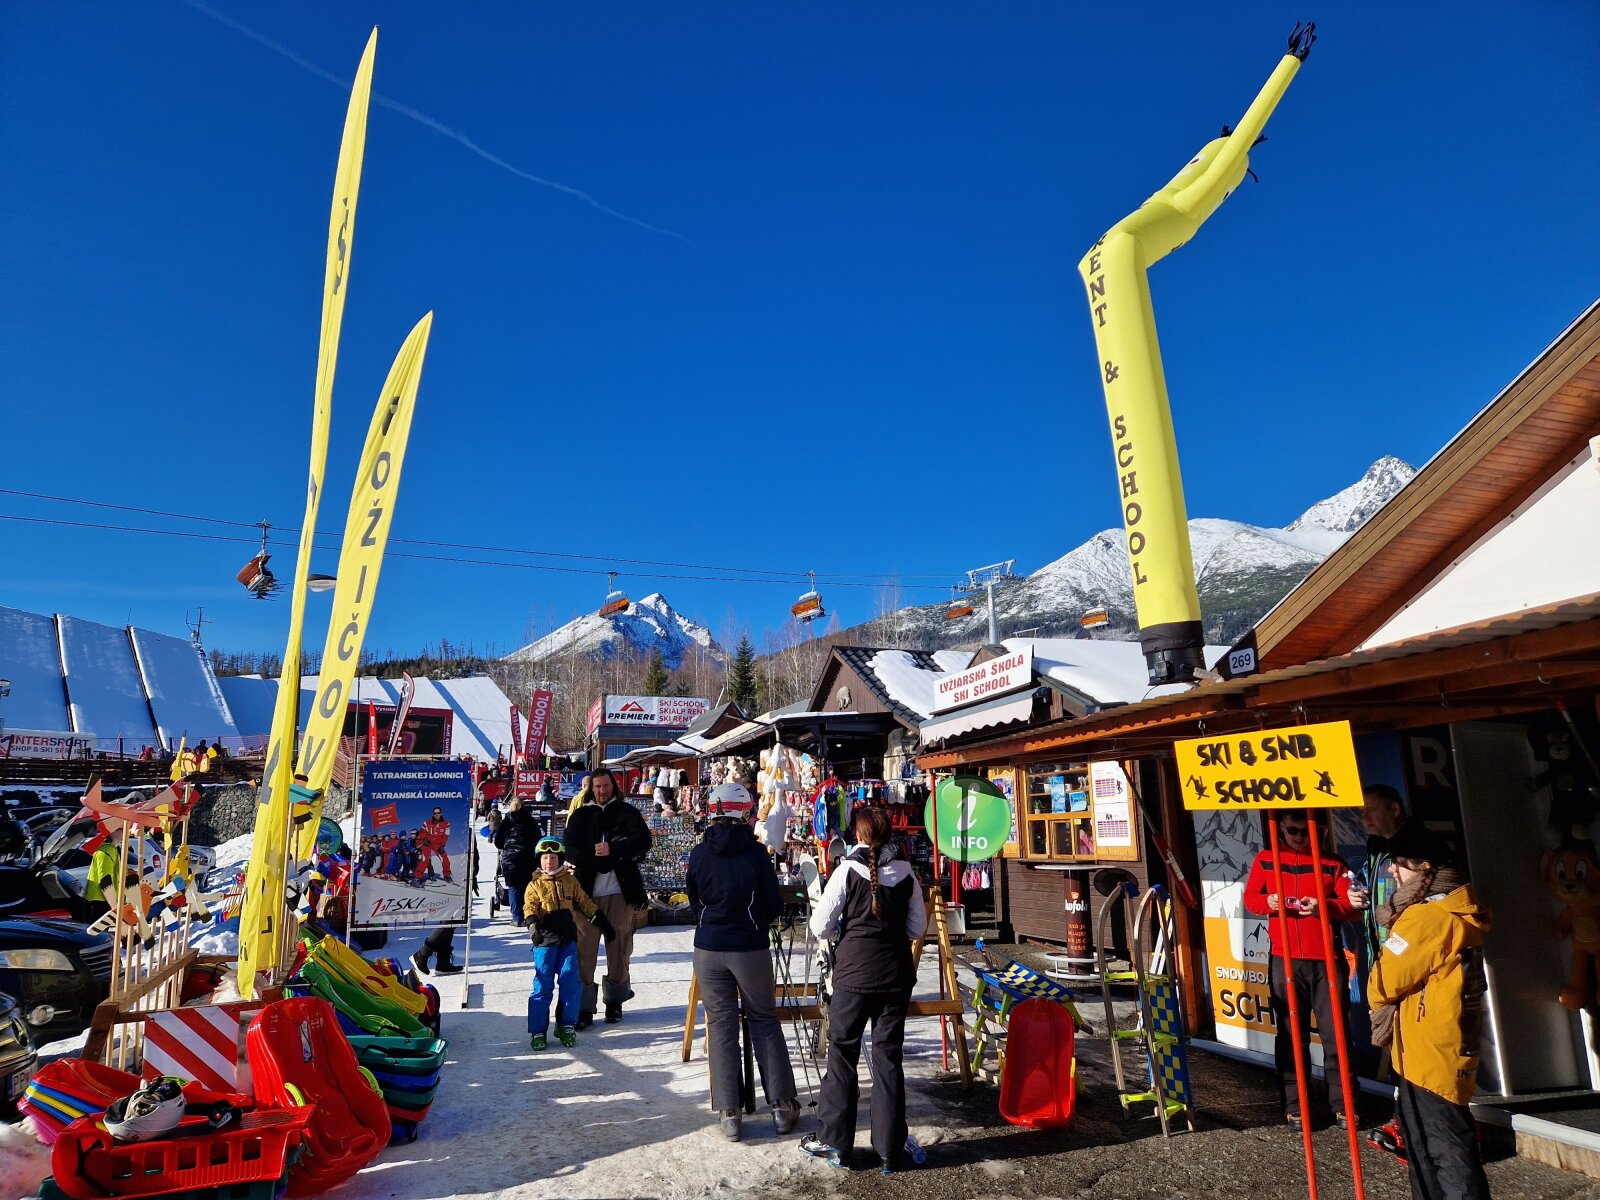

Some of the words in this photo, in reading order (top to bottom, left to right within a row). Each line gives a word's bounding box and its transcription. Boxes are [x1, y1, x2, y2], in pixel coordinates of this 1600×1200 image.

[1104, 360, 1120, 385] &
[1114, 414, 1148, 586] SCHOOL
[1231, 653, 1252, 669] 269
[940, 668, 987, 694] LYŽIARSKA
[990, 654, 1024, 676] ŠKOLA
[953, 688, 969, 703] SKI
[973, 675, 1011, 697] SCHOOL
[659, 707, 686, 715] SKIALP
[674, 700, 705, 708] SCHOOL
[531, 695, 550, 736] SCHOOL
[607, 712, 656, 721] PREMIERE
[12, 735, 90, 748] INTERSPORT
[528, 737, 538, 755] SKI
[55, 747, 86, 755] SERICE
[1196, 741, 1233, 770] SKI
[1238, 740, 1258, 766] &
[1261, 733, 1317, 762] SNB
[518, 773, 540, 783] SKI
[371, 791, 423, 799] TATRANSKÁ
[424, 791, 463, 799] LOMNICA
[1214, 776, 1307, 804] SCHOOL
[951, 836, 989, 850] INFO
[1215, 966, 1269, 985] SNOWBO
[1219, 988, 1277, 1027] SCH
